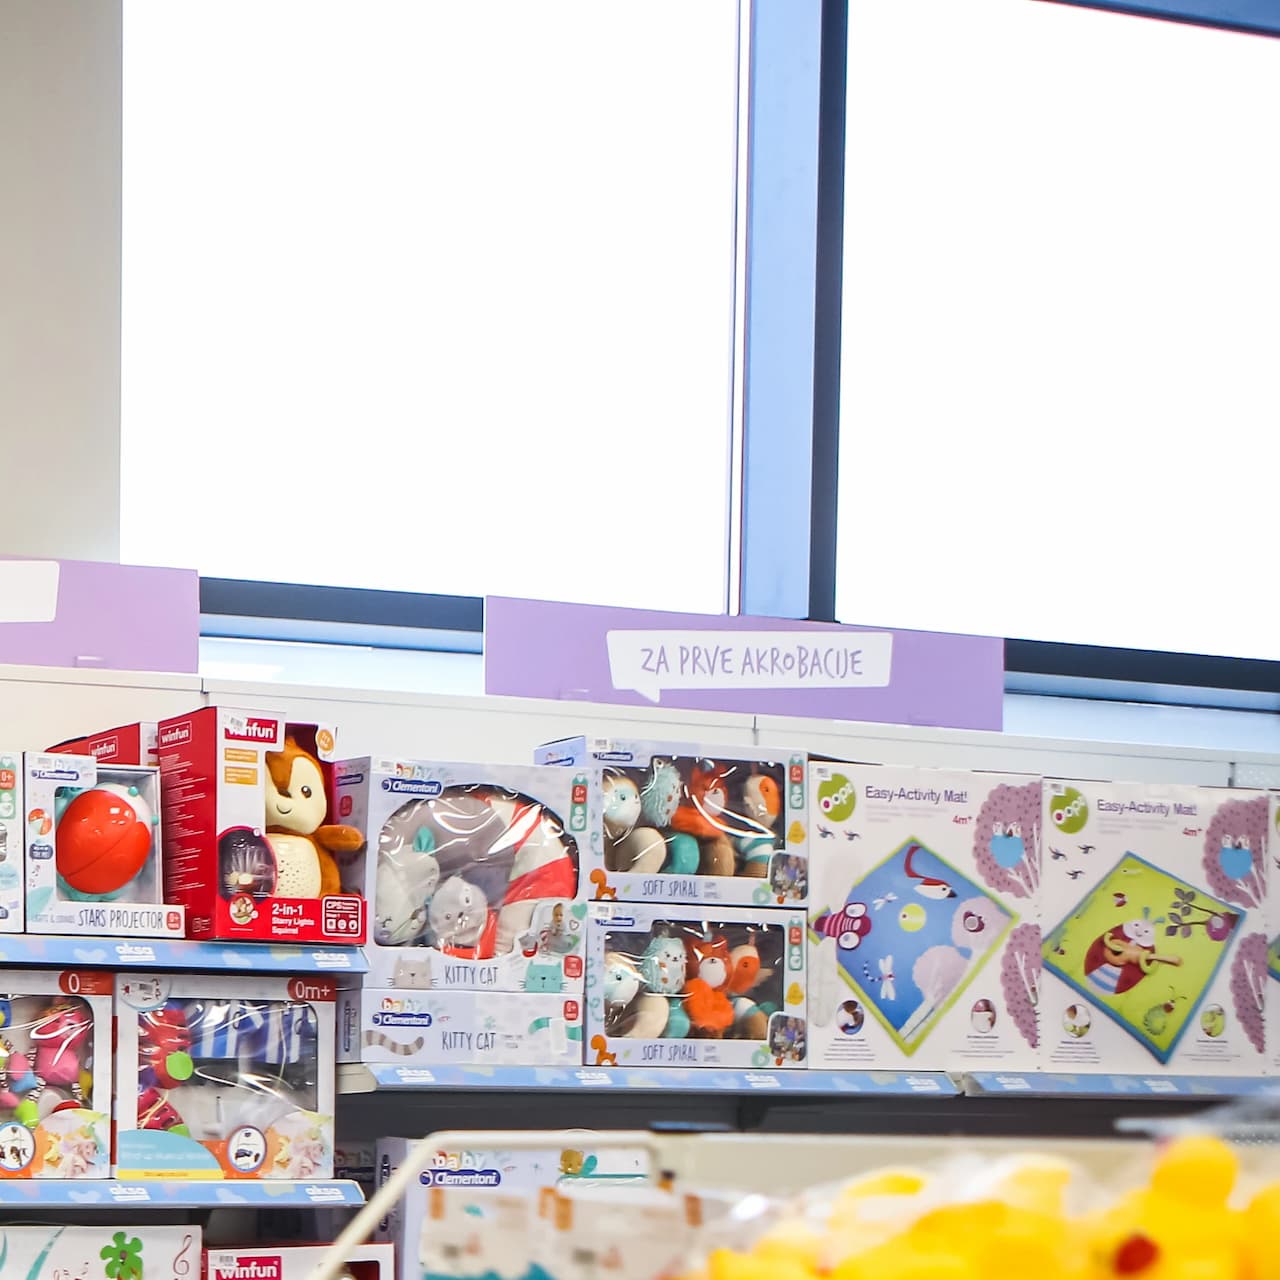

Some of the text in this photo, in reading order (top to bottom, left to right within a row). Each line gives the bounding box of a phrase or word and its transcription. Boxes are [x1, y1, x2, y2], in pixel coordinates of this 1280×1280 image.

[640, 645, 864, 679] ZA PRVE AKROBACIJE
[160, 725, 190, 743] winfun
[392, 781, 439, 793] Clementoni
[865, 786, 968, 804] Easy-Activity Mat!
[1097, 800, 1197, 817] Easy-Activity Mat!
[643, 880, 699, 897] SOFT SPIRAL
[78, 908, 163, 930] STARS PROJECTOR
[272, 904, 303, 917] 2-in-1
[445, 966, 497, 985] KITTY CAT
[295, 982, 330, 998] 0m+
[442, 1031, 496, 1050] KITTY CAT
[643, 1044, 698, 1061] SOFT SPIRAL
[435, 1171, 498, 1186] Clementoni
